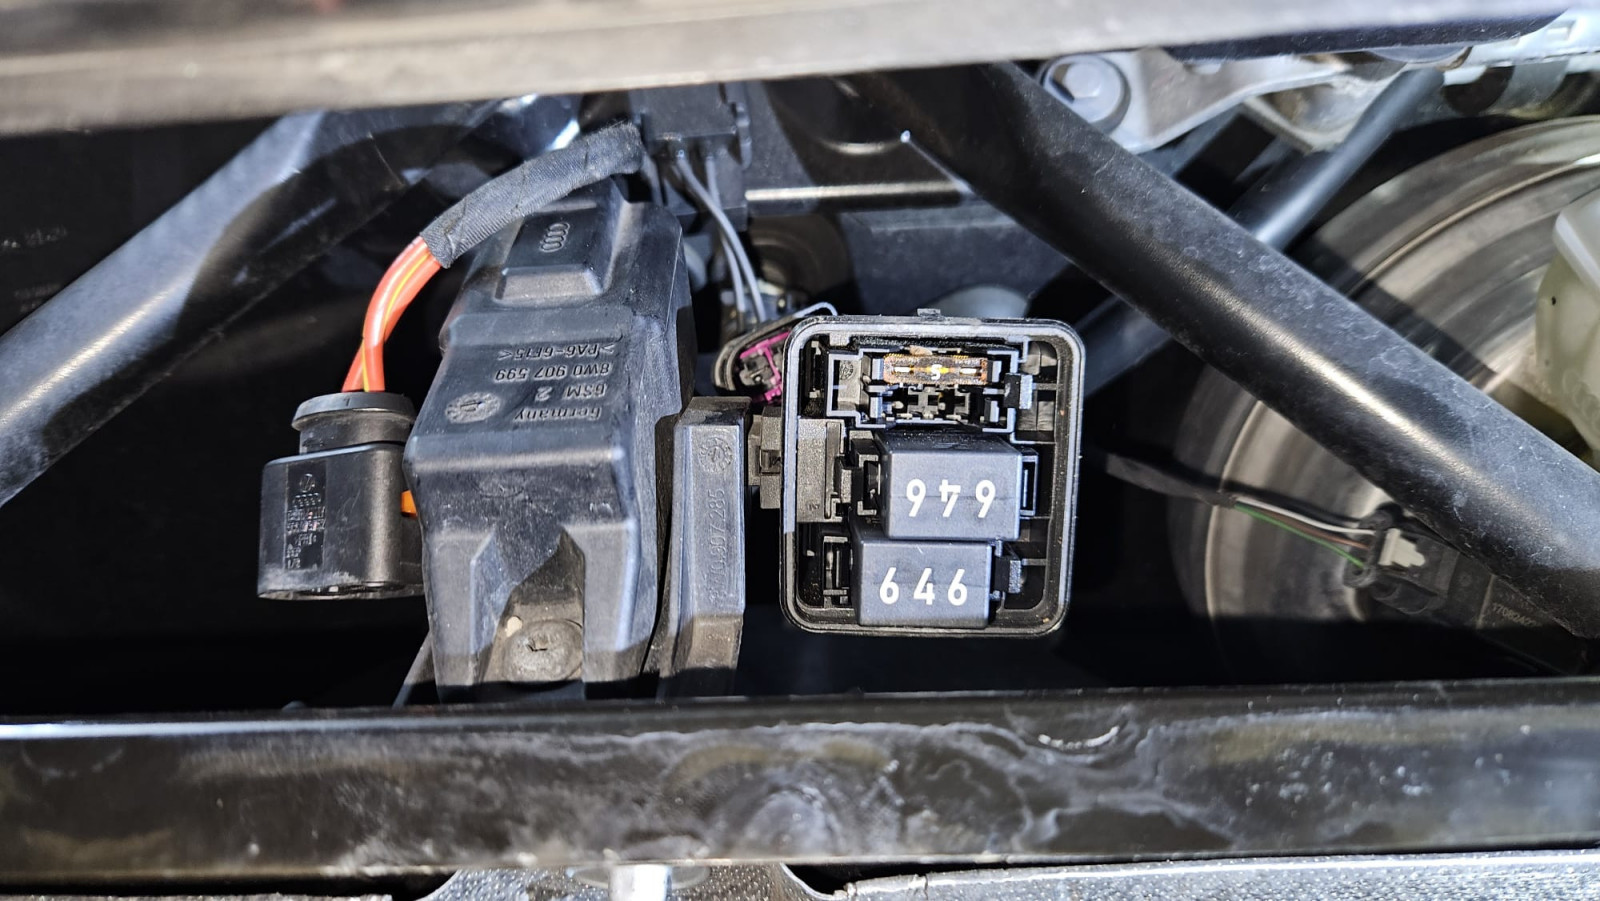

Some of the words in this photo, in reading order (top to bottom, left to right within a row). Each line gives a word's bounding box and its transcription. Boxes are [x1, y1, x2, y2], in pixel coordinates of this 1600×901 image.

[494, 367, 530, 383] 599
[533, 365, 567, 381] 907
[930, 364, 941, 380] 5
[535, 386, 554, 401] 2
[513, 406, 603, 423] Germany
[906, 479, 996, 518] 646
[879, 567, 968, 606] 646
